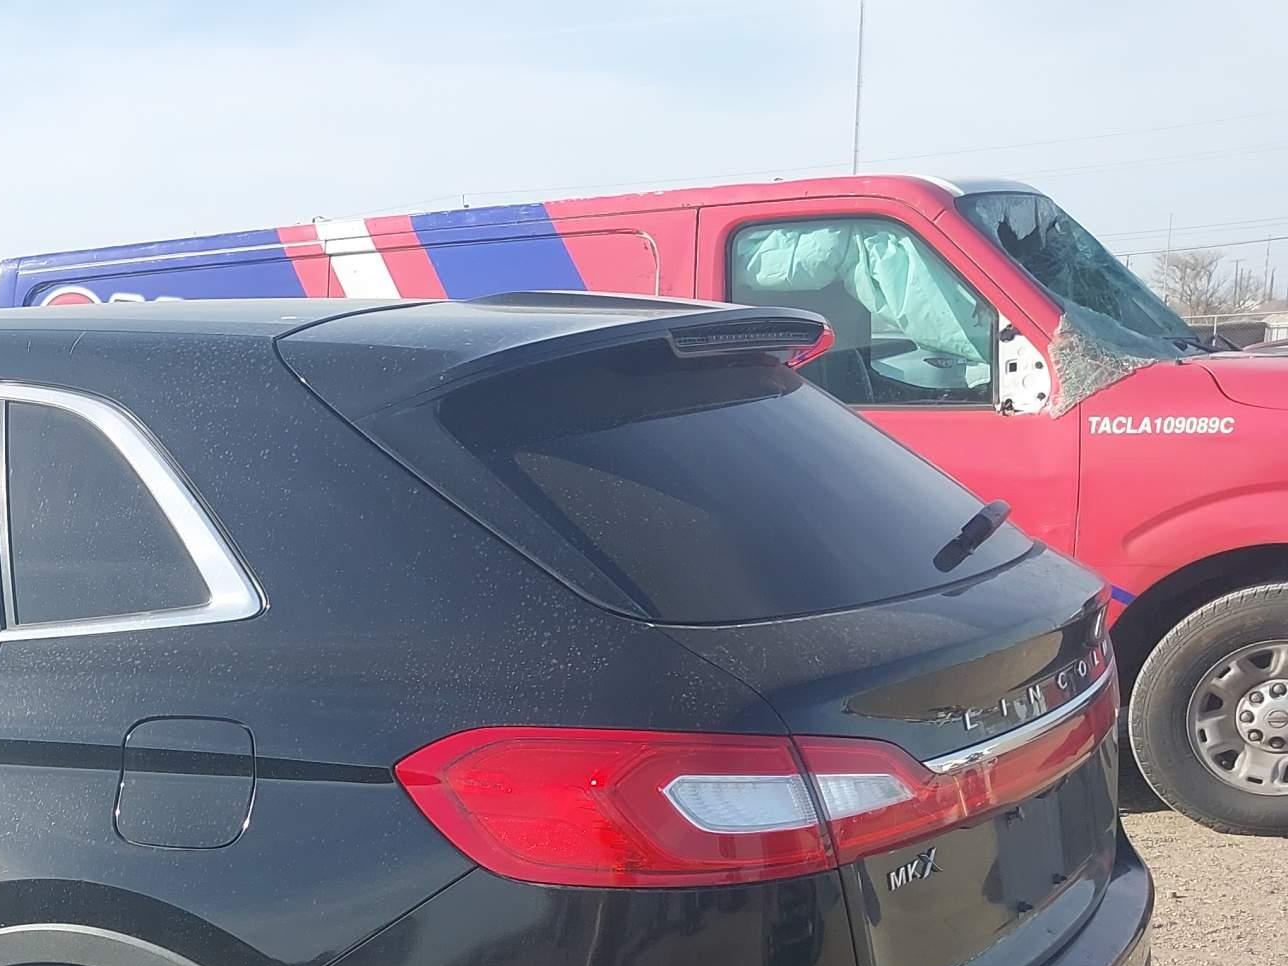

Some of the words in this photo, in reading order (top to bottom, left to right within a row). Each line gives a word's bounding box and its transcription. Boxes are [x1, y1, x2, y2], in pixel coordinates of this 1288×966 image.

[1087, 416, 1236, 435] TACLA109089C
[962, 639, 1108, 731] LINCOLN
[887, 846, 944, 891] MKX
